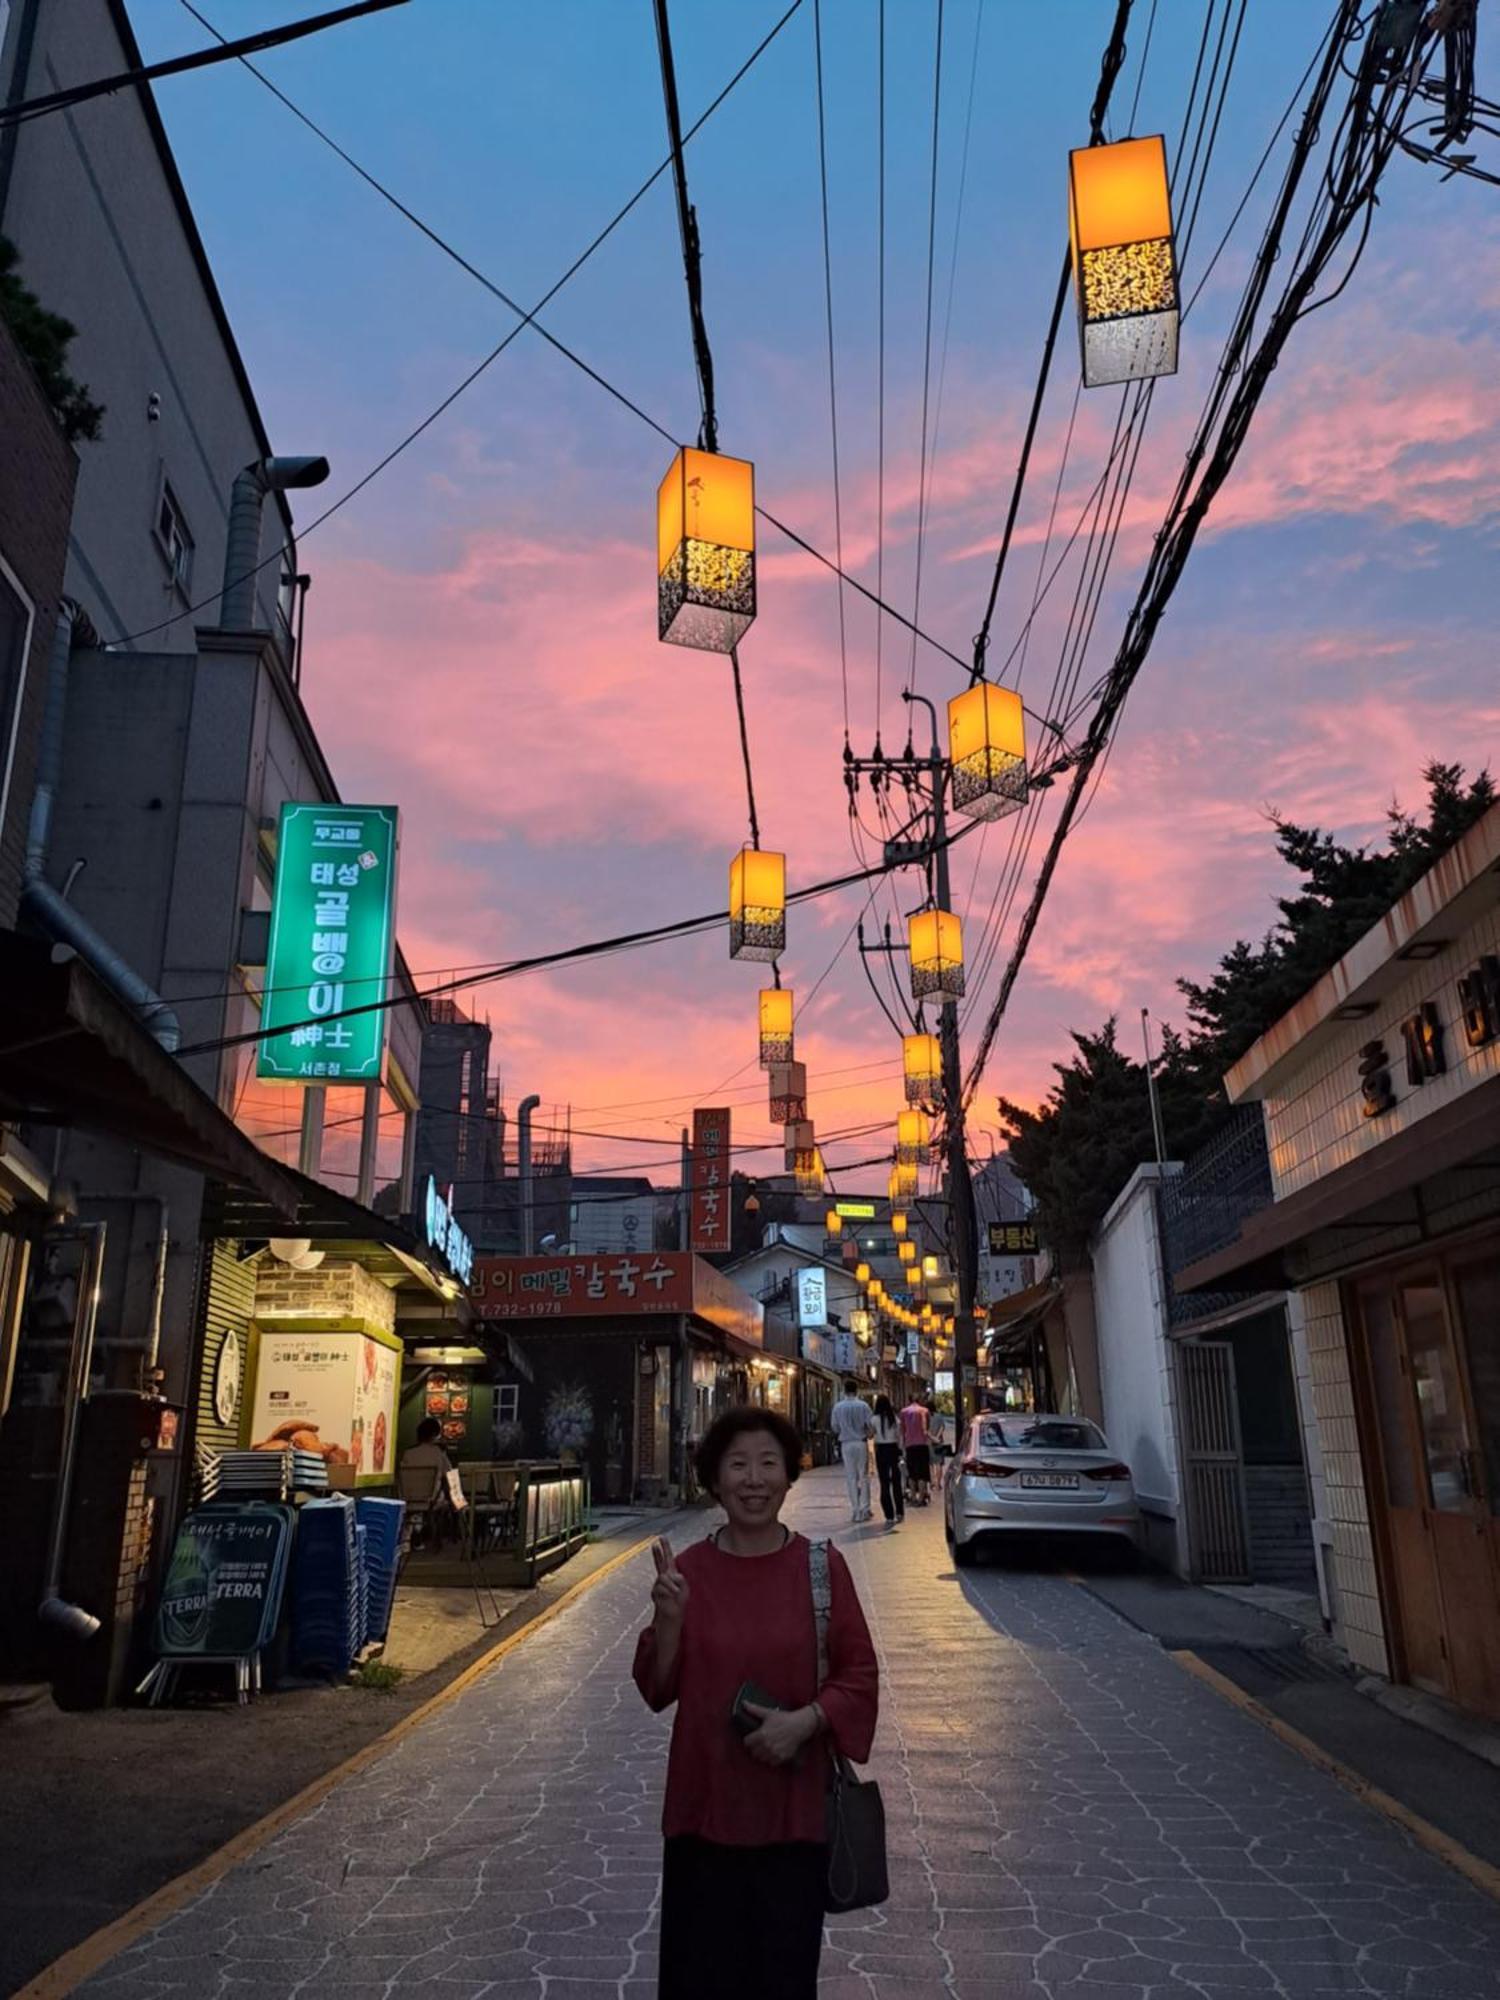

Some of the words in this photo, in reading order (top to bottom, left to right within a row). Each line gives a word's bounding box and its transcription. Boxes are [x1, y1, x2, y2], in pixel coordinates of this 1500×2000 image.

[310, 863, 359, 886] 태성
[299, 1062, 340, 1076] 서촌점
[990, 1226, 1036, 1249] 부동산
[216, 1582, 263, 1600] TERRA
[165, 1595, 207, 1616] TERRA
